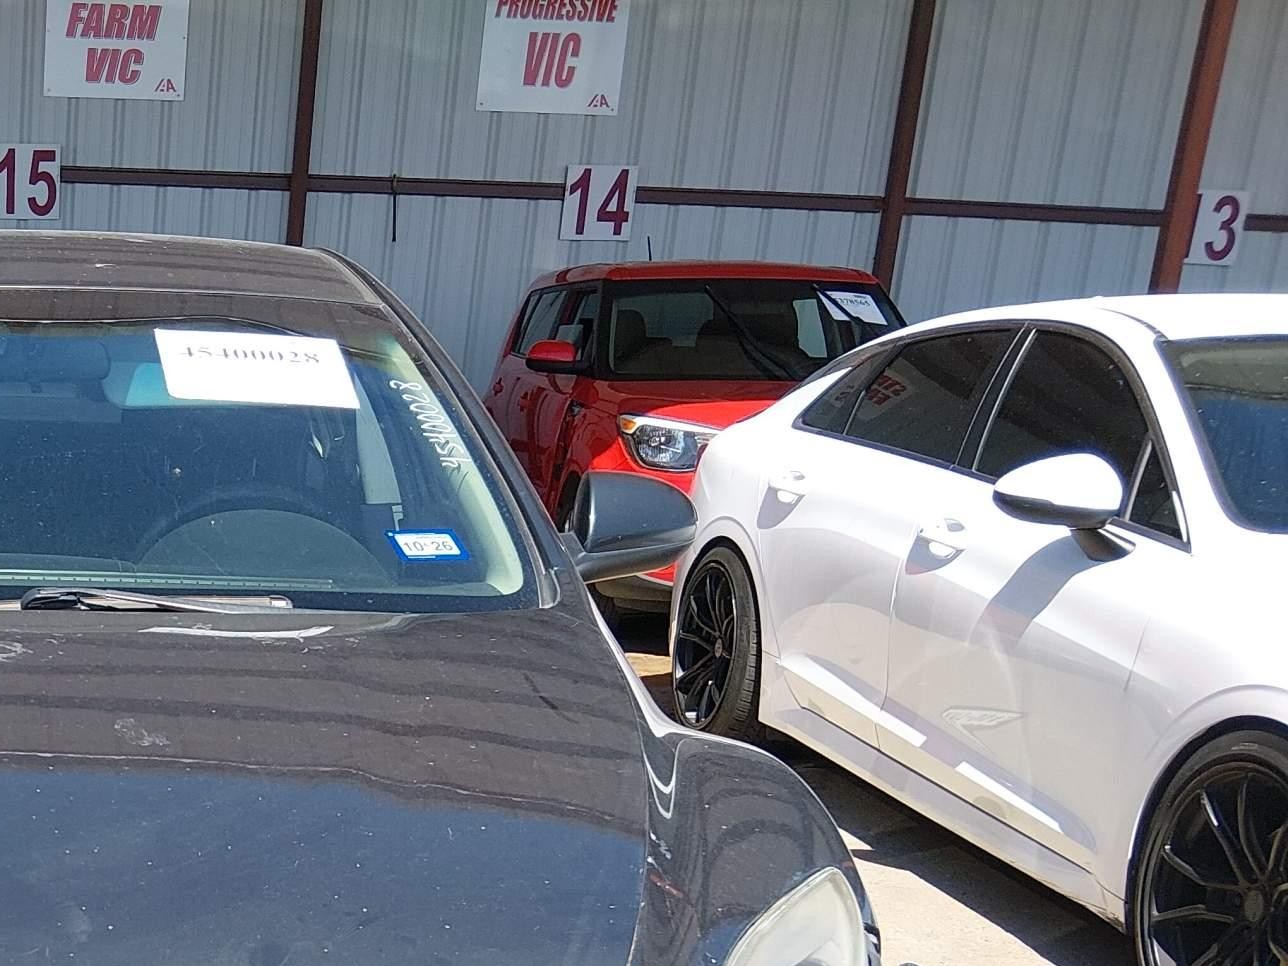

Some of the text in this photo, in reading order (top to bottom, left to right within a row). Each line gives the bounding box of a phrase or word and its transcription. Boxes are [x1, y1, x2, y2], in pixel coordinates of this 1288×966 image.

[65, 2, 162, 41] FARM
[494, 0, 618, 23] PROGRESSIVE
[85, 47, 145, 85] VIC
[523, 31, 582, 88] VIC
[569, 168, 630, 236] 14
